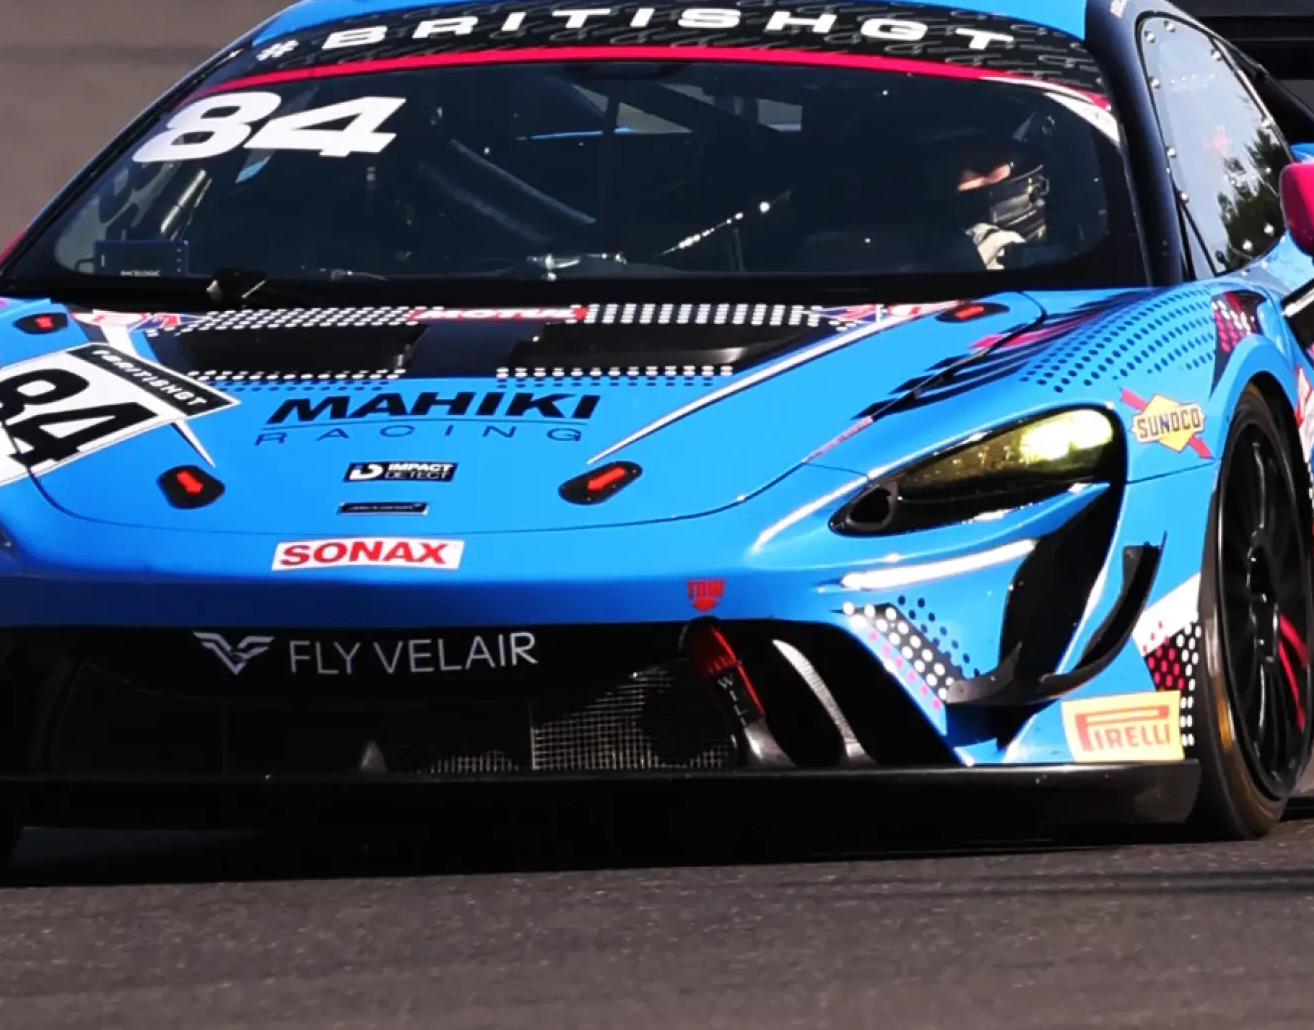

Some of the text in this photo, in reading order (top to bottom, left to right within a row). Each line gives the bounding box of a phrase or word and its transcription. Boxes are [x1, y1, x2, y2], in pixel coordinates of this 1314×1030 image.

[132, 91, 406, 163] 84
[266, 392, 600, 425] MAHIKI
[1137, 408, 1202, 439] SUNOCO
[255, 425, 582, 446] RACING
[387, 462, 454, 472] IMPACT
[279, 541, 448, 566] SONAX
[289, 632, 539, 675] FLY VELAIR
[1074, 704, 1171, 753] PIRELLI
